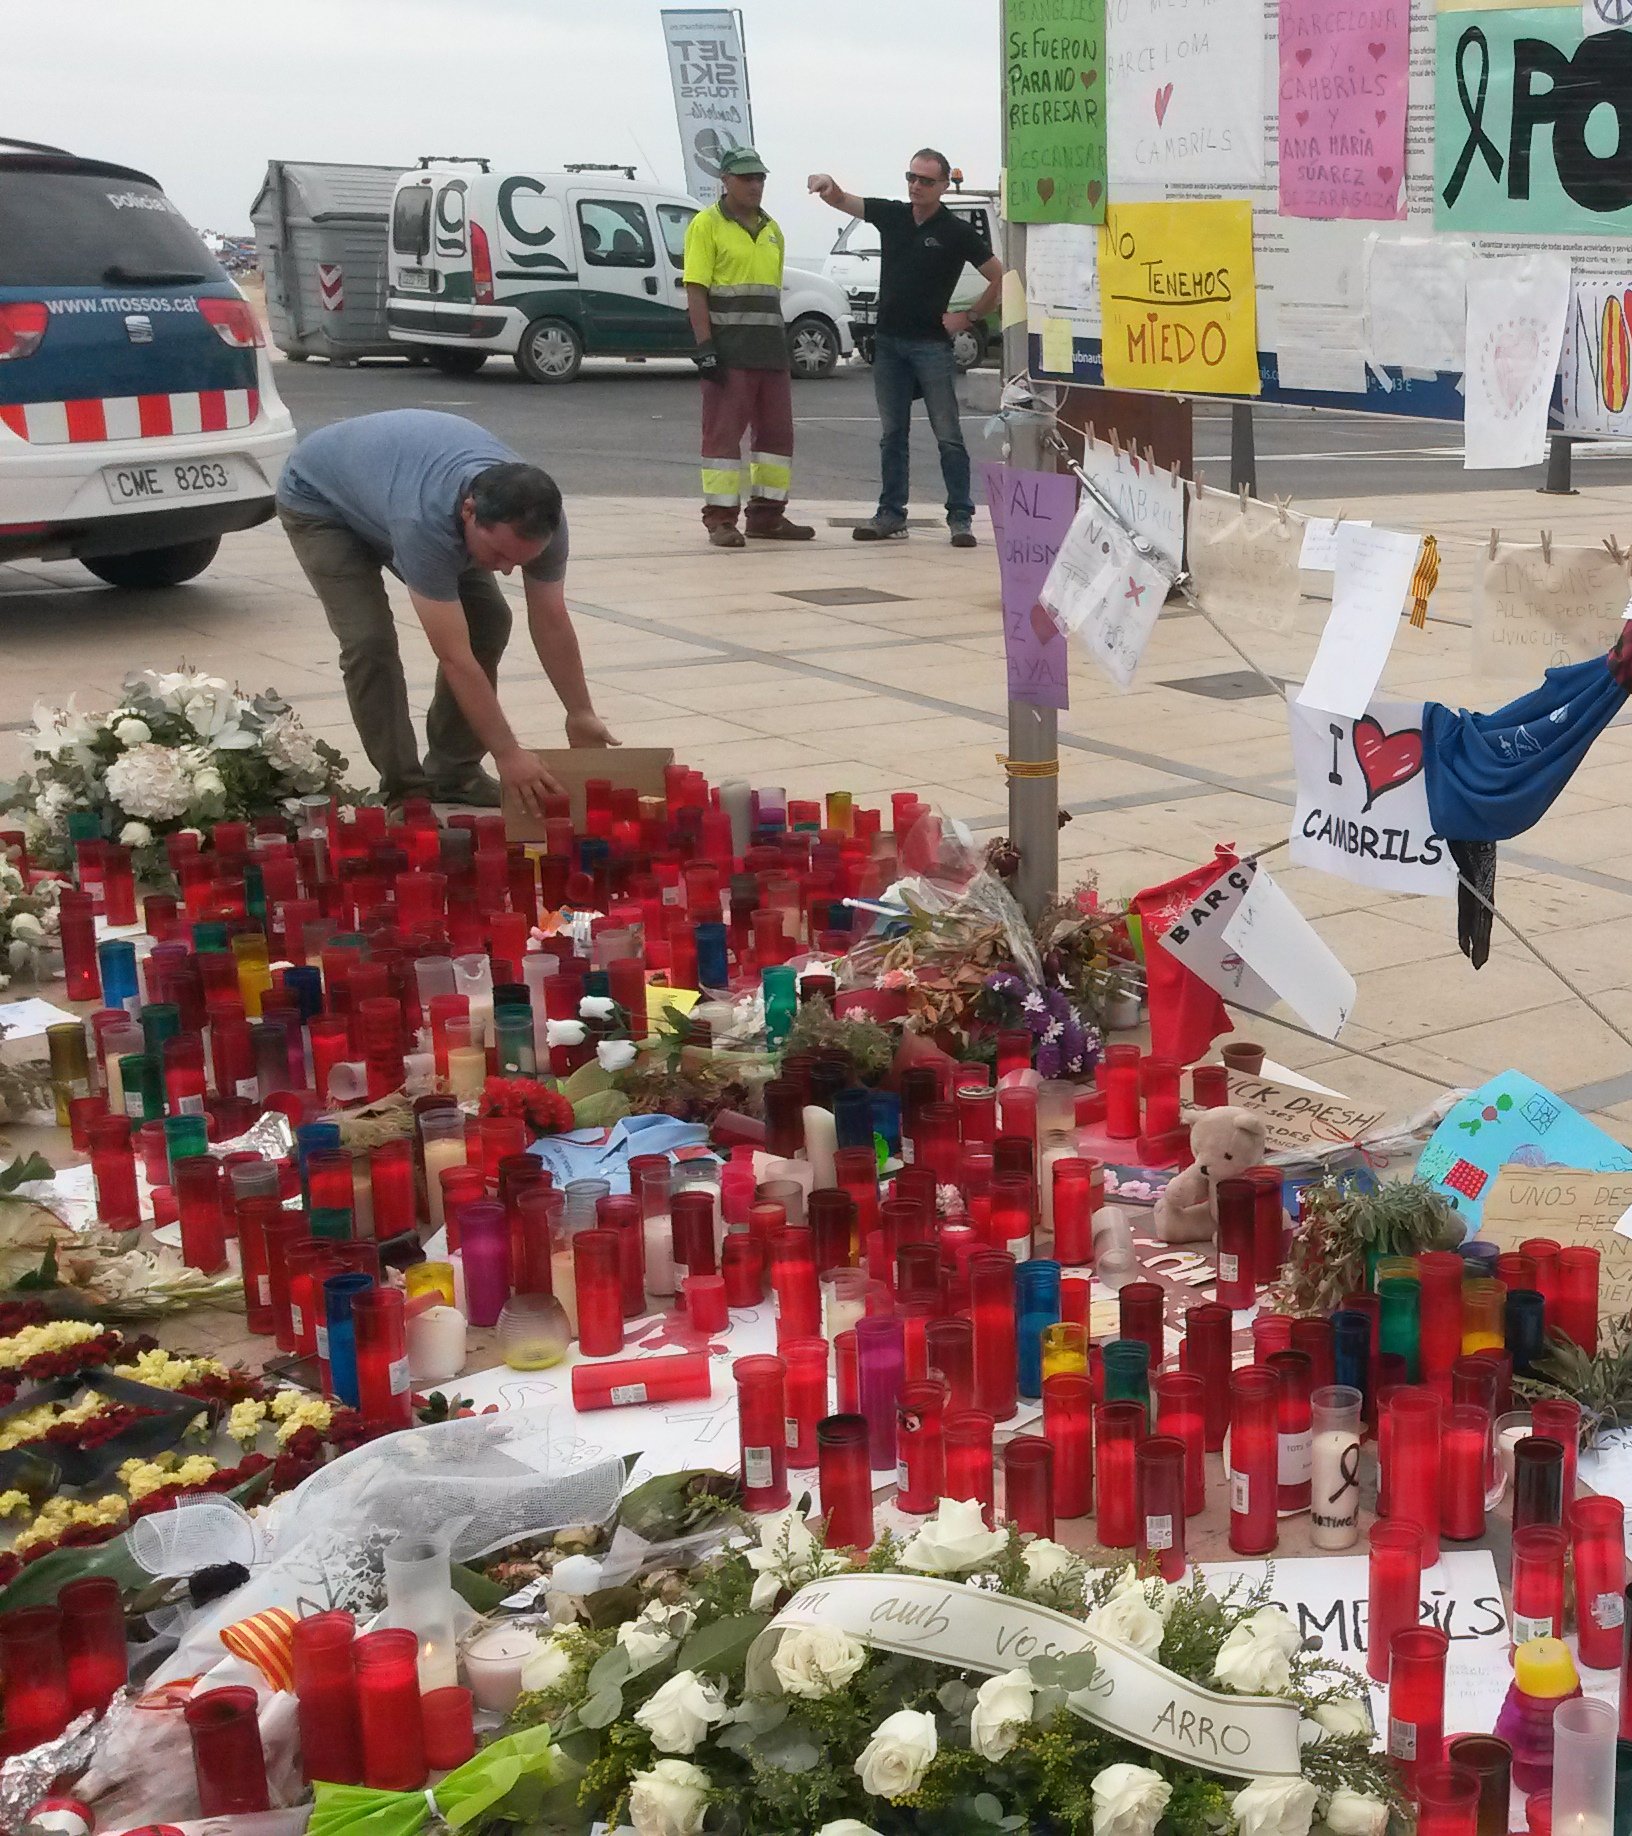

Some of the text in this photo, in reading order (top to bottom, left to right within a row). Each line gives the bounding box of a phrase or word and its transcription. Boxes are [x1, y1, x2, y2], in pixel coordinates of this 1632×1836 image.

[1279, 2, 1397, 45] BARCELONA
[1108, 33, 1209, 84] BARCELONA
[1009, 99, 1098, 130] REGRESAR
[1284, 137, 1320, 158] ANA
[1140, 259, 1232, 300] TENEMOS
[46, 296, 200, 314] www.mossos.cat
[117, 463, 228, 498] CME 8263
[1328, 722, 1344, 786] I
[1302, 808, 1445, 866] CAMBRILS
[1285, 1097, 1376, 1129] DAESH
[1509, 1183, 1577, 1206] UNOS
[1150, 1698, 1251, 1757] ARRO
